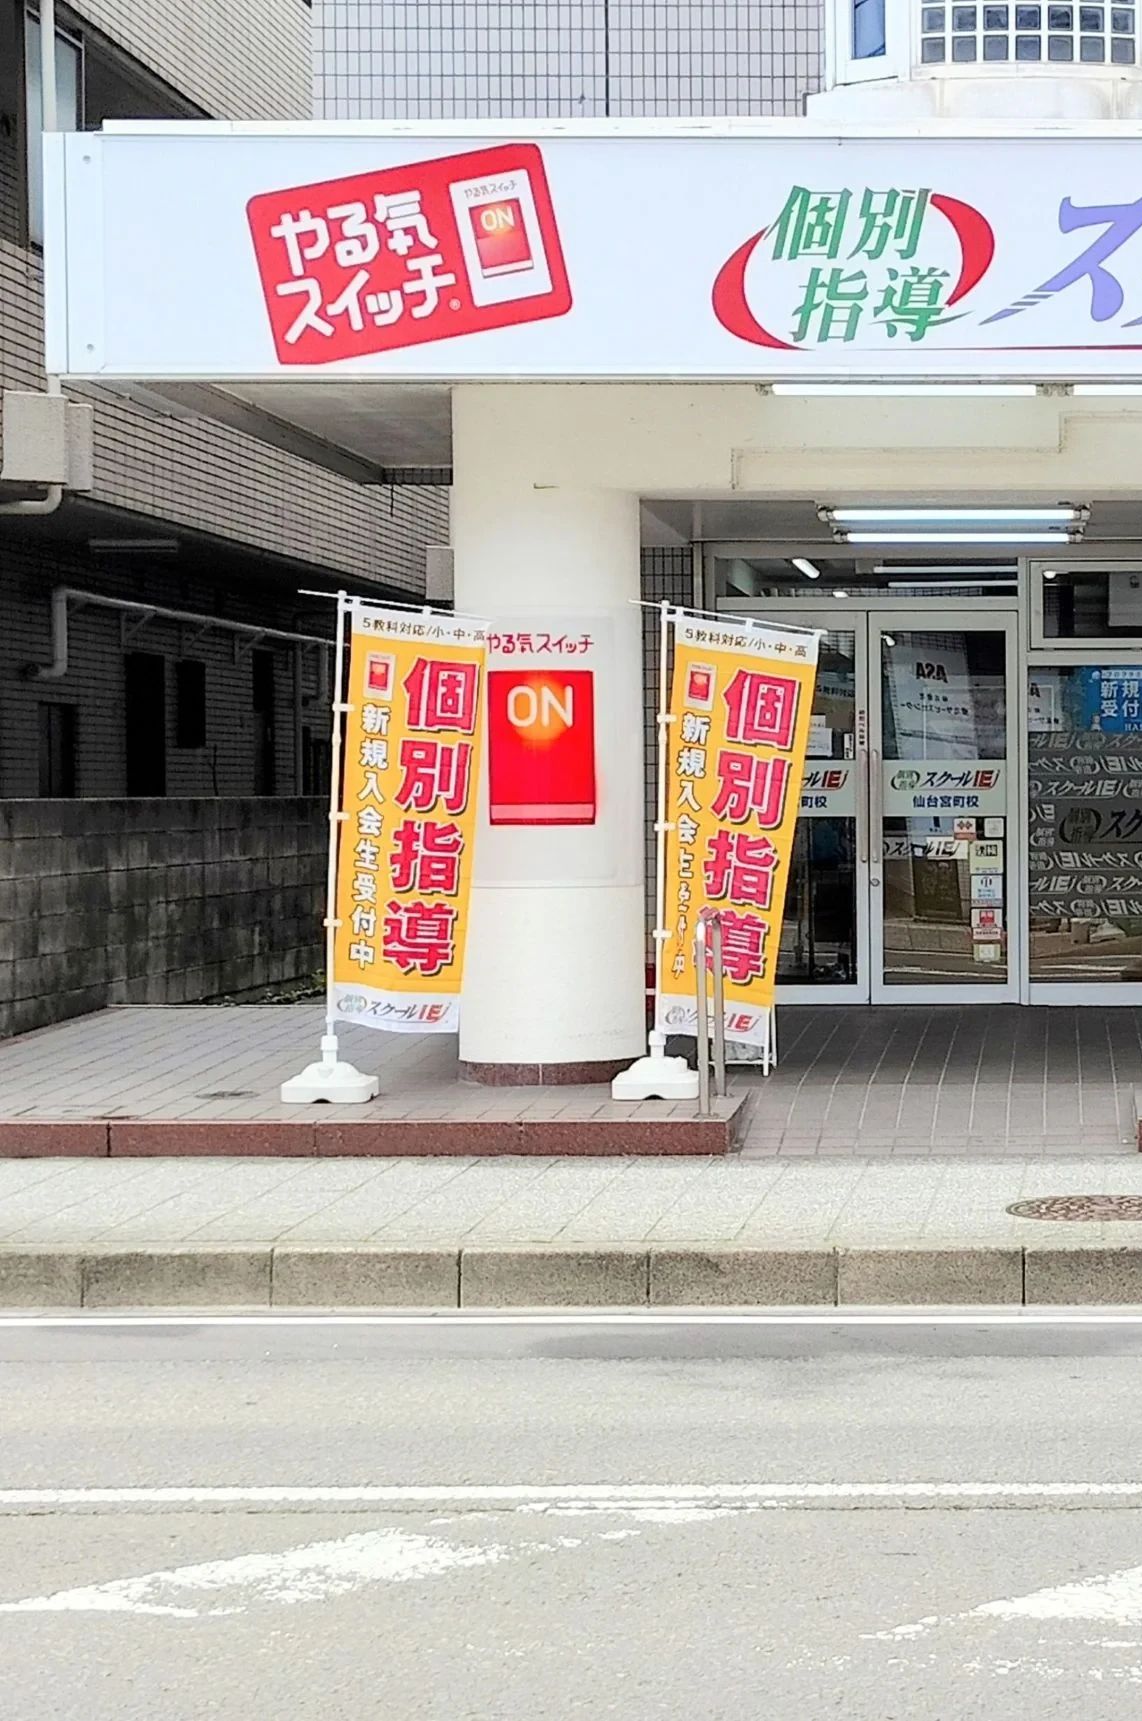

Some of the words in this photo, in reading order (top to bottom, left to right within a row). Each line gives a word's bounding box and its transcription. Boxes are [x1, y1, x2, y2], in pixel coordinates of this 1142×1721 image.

[271, 190, 438, 276] やる気
[480, 205, 515, 231] ON
[763, 185, 932, 260] 個別
[275, 253, 456, 344] スイッチ
[789, 266, 951, 343] 指導
[486, 632, 594, 655] やる気スイッチ
[507, 685, 574, 728] ON
[381, 656, 480, 976] 個別指導
[913, 796, 979, 808] 仙台宮町校
[921, 770, 995, 788] スクールIE
[349, 702, 391, 970] 新規入会生受付中
